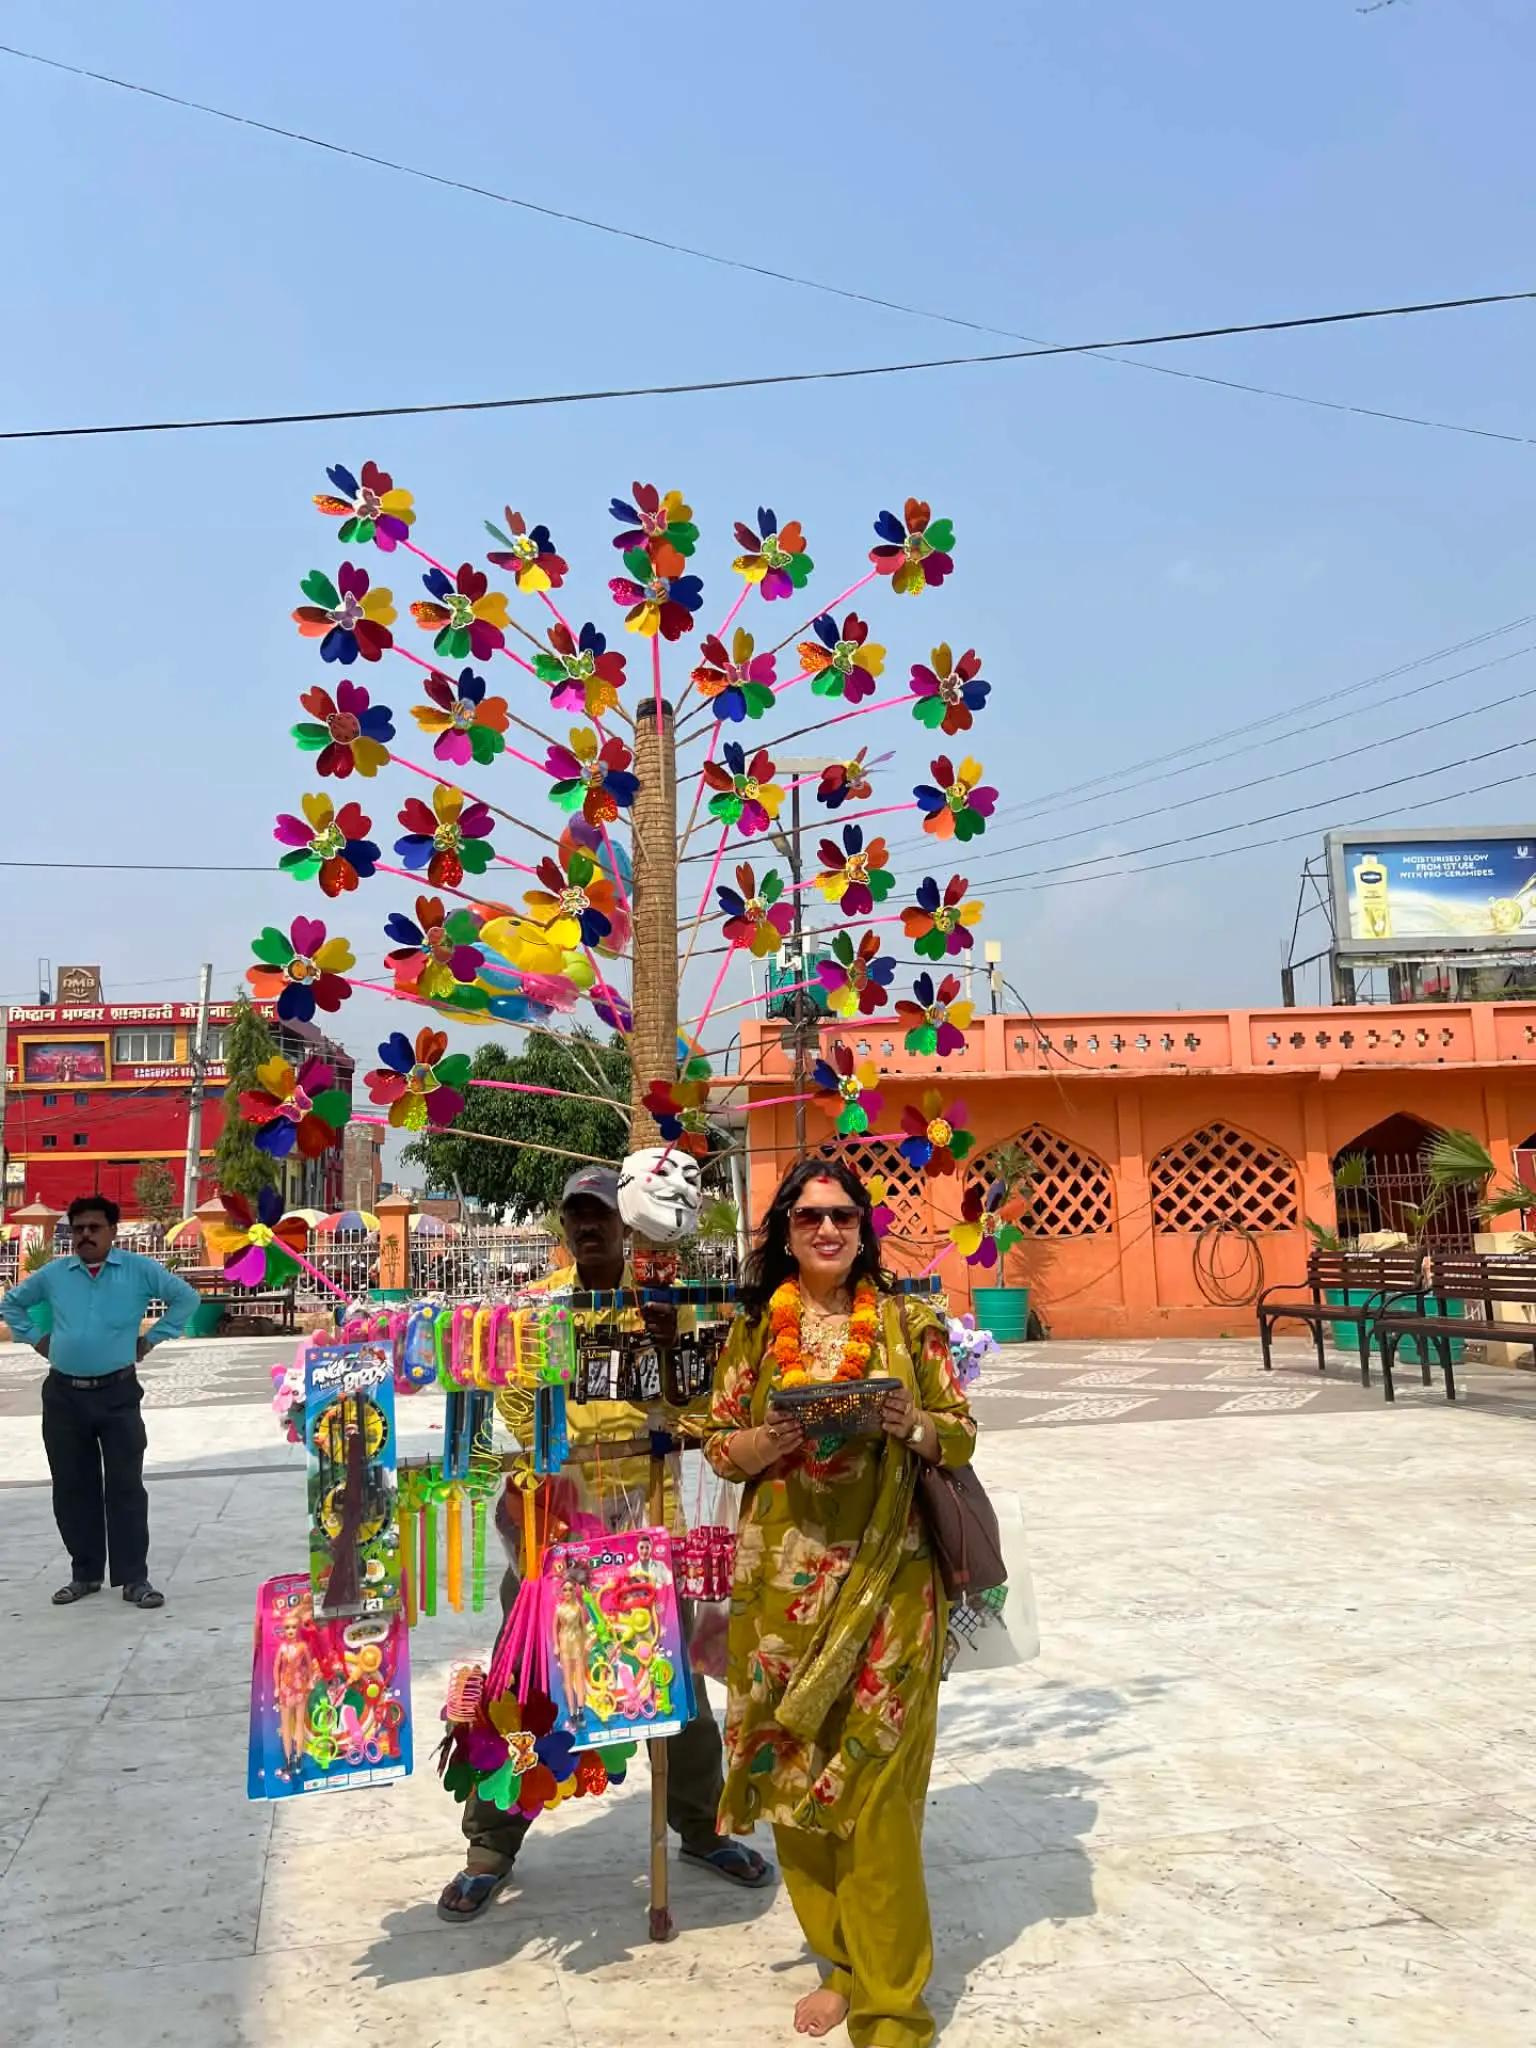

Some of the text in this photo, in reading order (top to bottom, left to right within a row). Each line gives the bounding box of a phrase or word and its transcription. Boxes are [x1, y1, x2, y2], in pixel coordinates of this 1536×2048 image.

[1402, 853, 1489, 864] MOISTURISED GLOW
[1416, 863, 1441, 871] FROM
[1400, 871, 1423, 879] WITH
